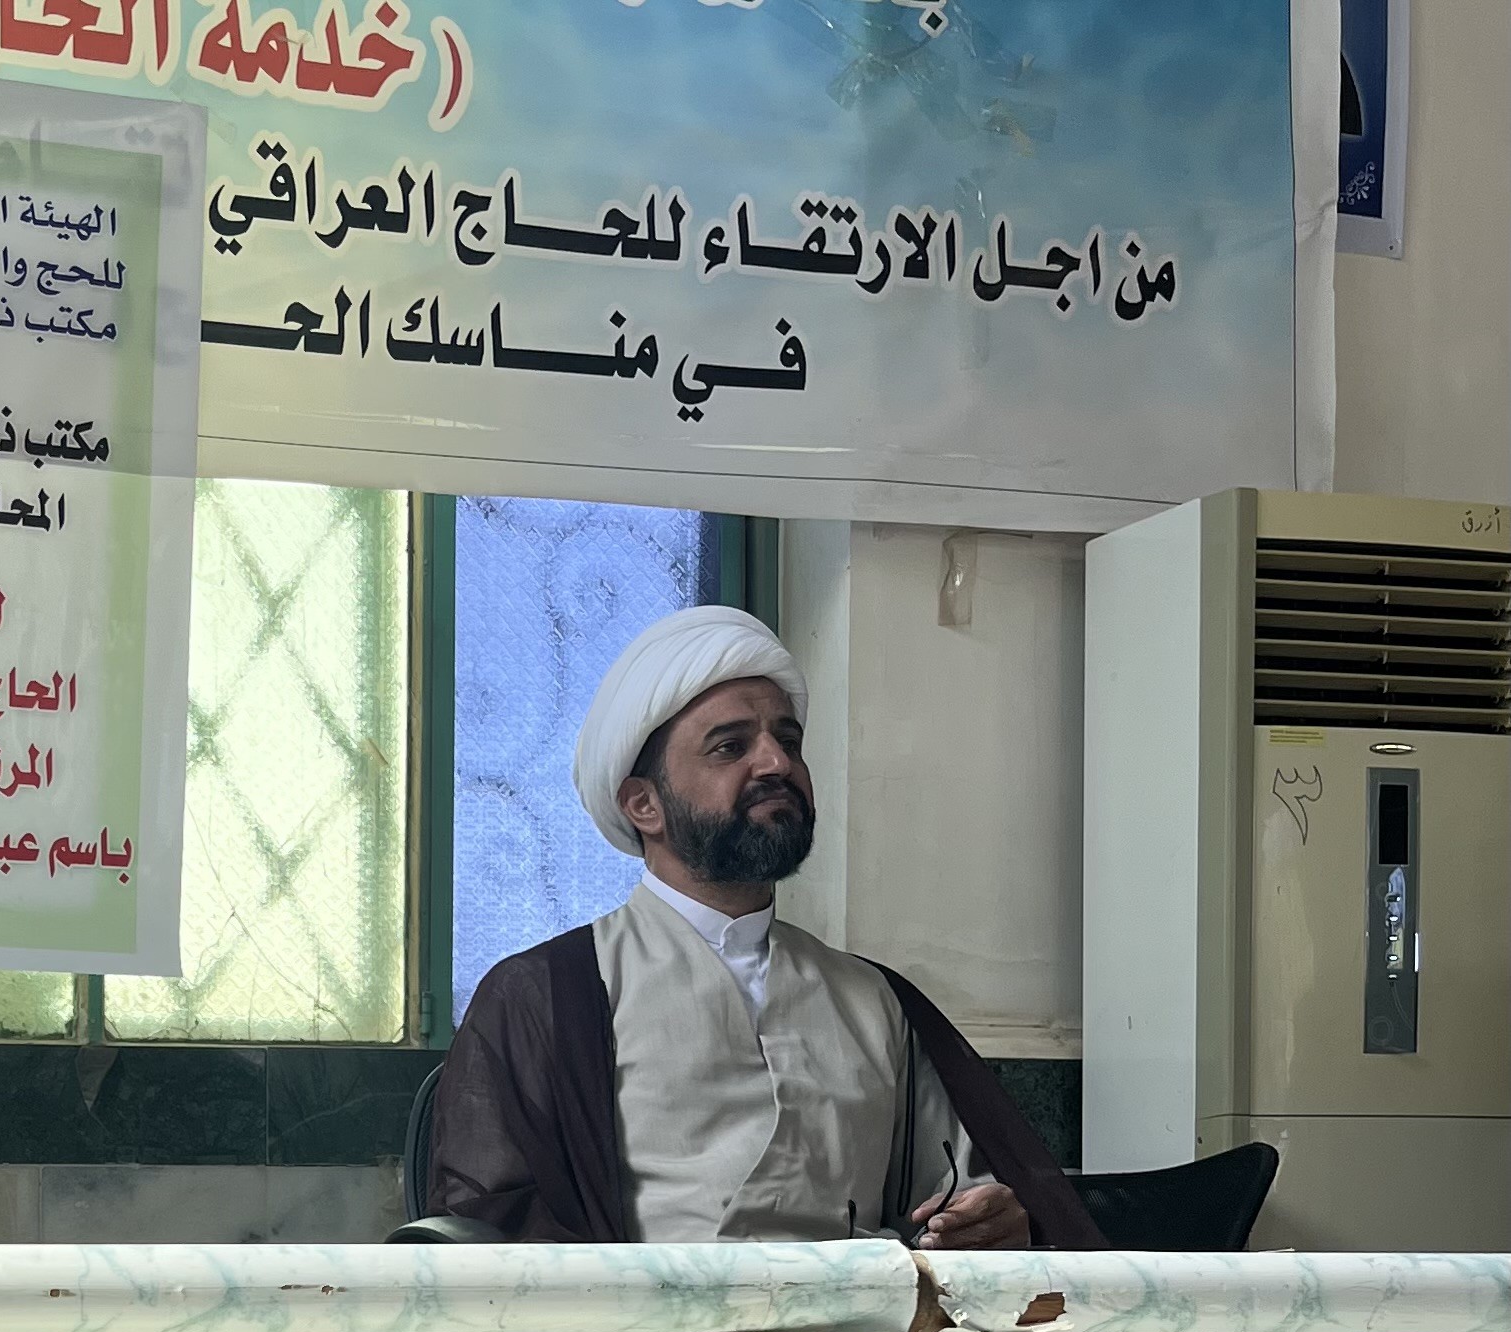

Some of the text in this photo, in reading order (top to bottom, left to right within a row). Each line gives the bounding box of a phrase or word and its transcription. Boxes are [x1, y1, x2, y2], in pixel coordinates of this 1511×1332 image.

[19, 196, 115, 240] الهيئة
[209, 141, 434, 255] العراقي
[454, 177, 685, 265] للحاج
[37, 258, 125, 295] للحج
[704, 199, 955, 294] الارتقاء
[973, 221, 1100, 312] اجل
[1115, 241, 1175, 320] من
[25, 306, 116, 343] مكتب
[201, 286, 806, 422] في مناسك الح
[25, 420, 109, 468] مكتب
[50, 827, 132, 883] باسم
